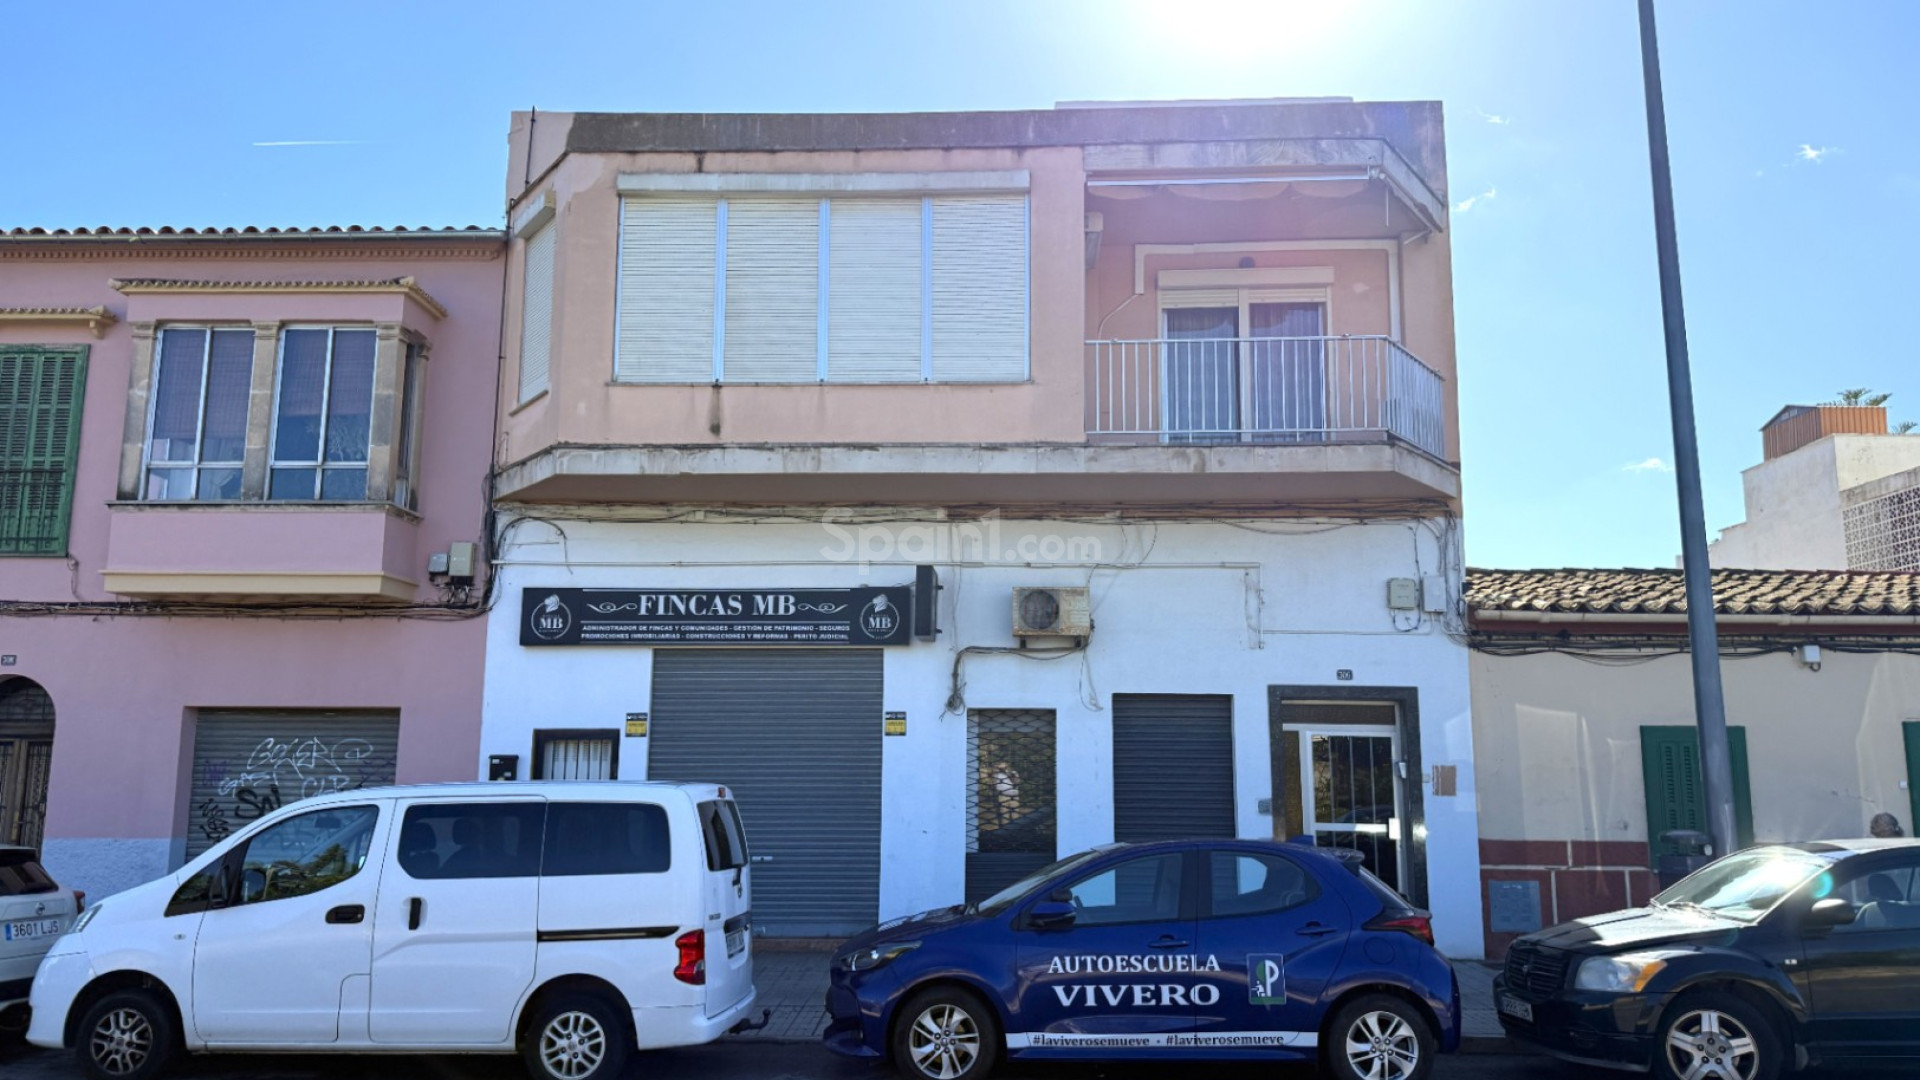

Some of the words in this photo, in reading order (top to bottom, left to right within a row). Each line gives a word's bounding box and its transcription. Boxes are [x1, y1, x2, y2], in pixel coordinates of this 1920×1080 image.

[638, 594, 742, 616] FINCAS
[752, 594, 797, 616] MB
[538, 617, 563, 629] MB
[868, 616, 892, 629] MB
[13, 922, 38, 937] 3601
[41, 920, 59, 935] LJS
[1047, 954, 1221, 974] AUTOESCUELA
[1052, 984, 1220, 1007] VIVERO
[1033, 1033, 1150, 1046] #laviverosemueve
[1166, 1033, 1285, 1046] #laviverosemueve
